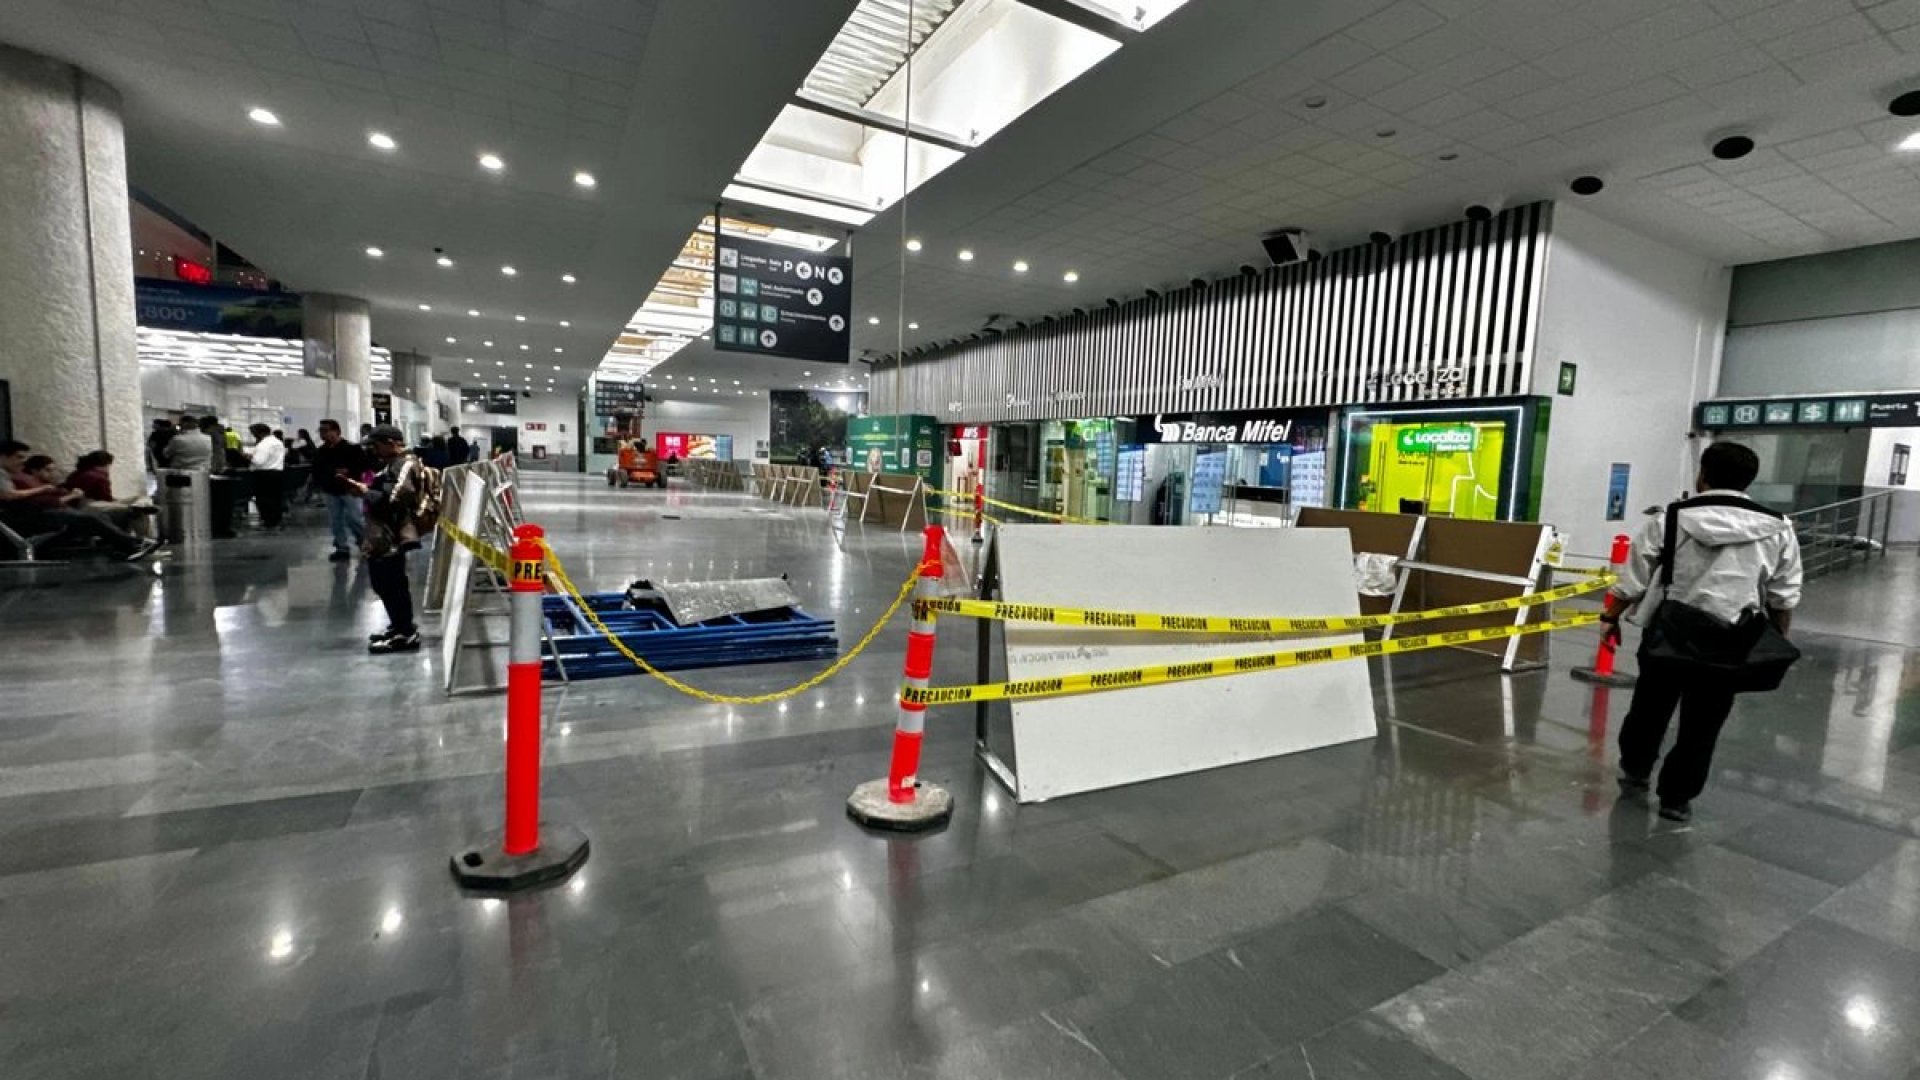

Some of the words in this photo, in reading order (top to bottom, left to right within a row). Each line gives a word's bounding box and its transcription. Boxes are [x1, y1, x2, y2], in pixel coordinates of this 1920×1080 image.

[783, 260, 793, 273] P
[814, 266, 826, 280] N
[1181, 421, 1238, 442] Banca
[1241, 419, 1292, 442] Mifel
[514, 562, 542, 580] PRE
[1083, 610, 1137, 627] PRECAUCION
[1161, 615, 1208, 630] PRECAUCION
[1003, 678, 1063, 695] PRECAUCION
[1090, 670, 1143, 686] PRECAUCION
[1167, 662, 1214, 678] PRECAUCION
[1235, 655, 1276, 671] PRECAUCION
